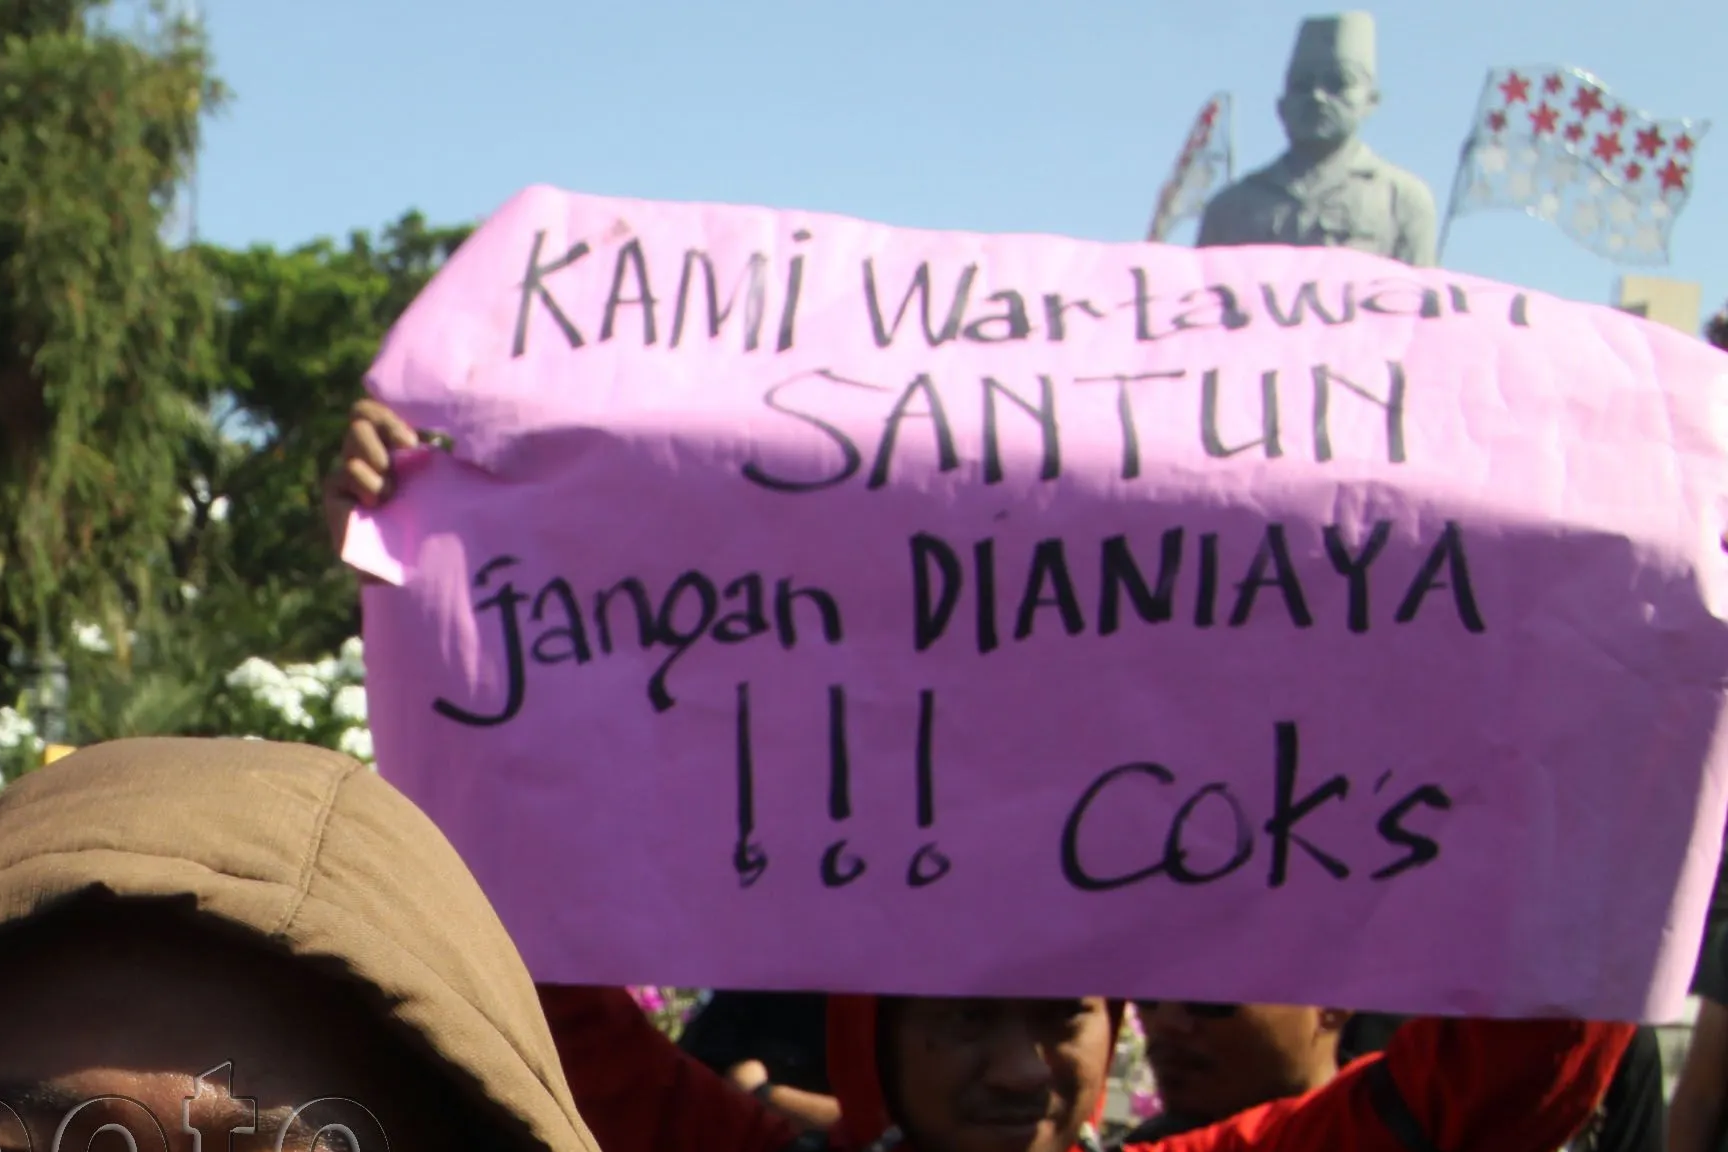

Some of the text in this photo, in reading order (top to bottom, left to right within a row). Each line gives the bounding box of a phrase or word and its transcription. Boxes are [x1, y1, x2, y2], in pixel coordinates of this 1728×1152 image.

[742, 358, 1408, 494] SANTUN
[432, 518, 1486, 726] jangan DIANIAYA
